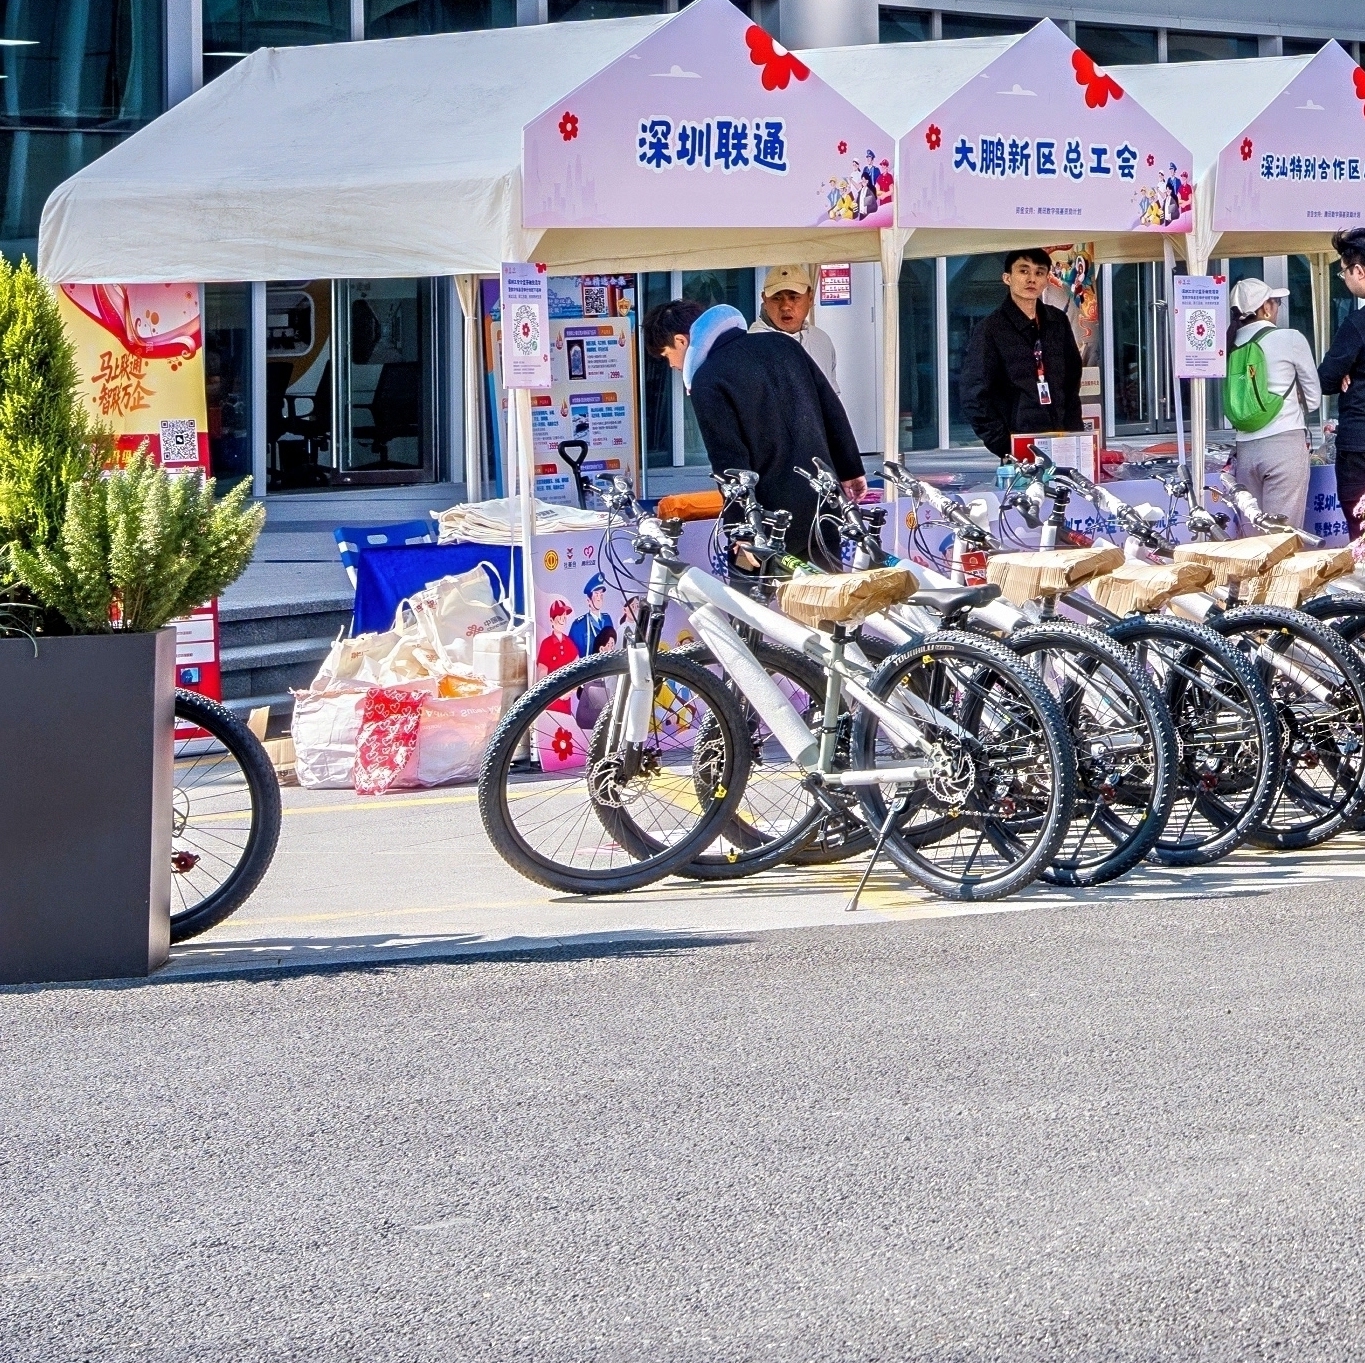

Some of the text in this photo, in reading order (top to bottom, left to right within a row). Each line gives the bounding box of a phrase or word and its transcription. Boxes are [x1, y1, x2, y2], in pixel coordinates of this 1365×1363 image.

[638, 119, 787, 171] 深圳联通
[954, 139, 1137, 179] 大鹏新区总工会
